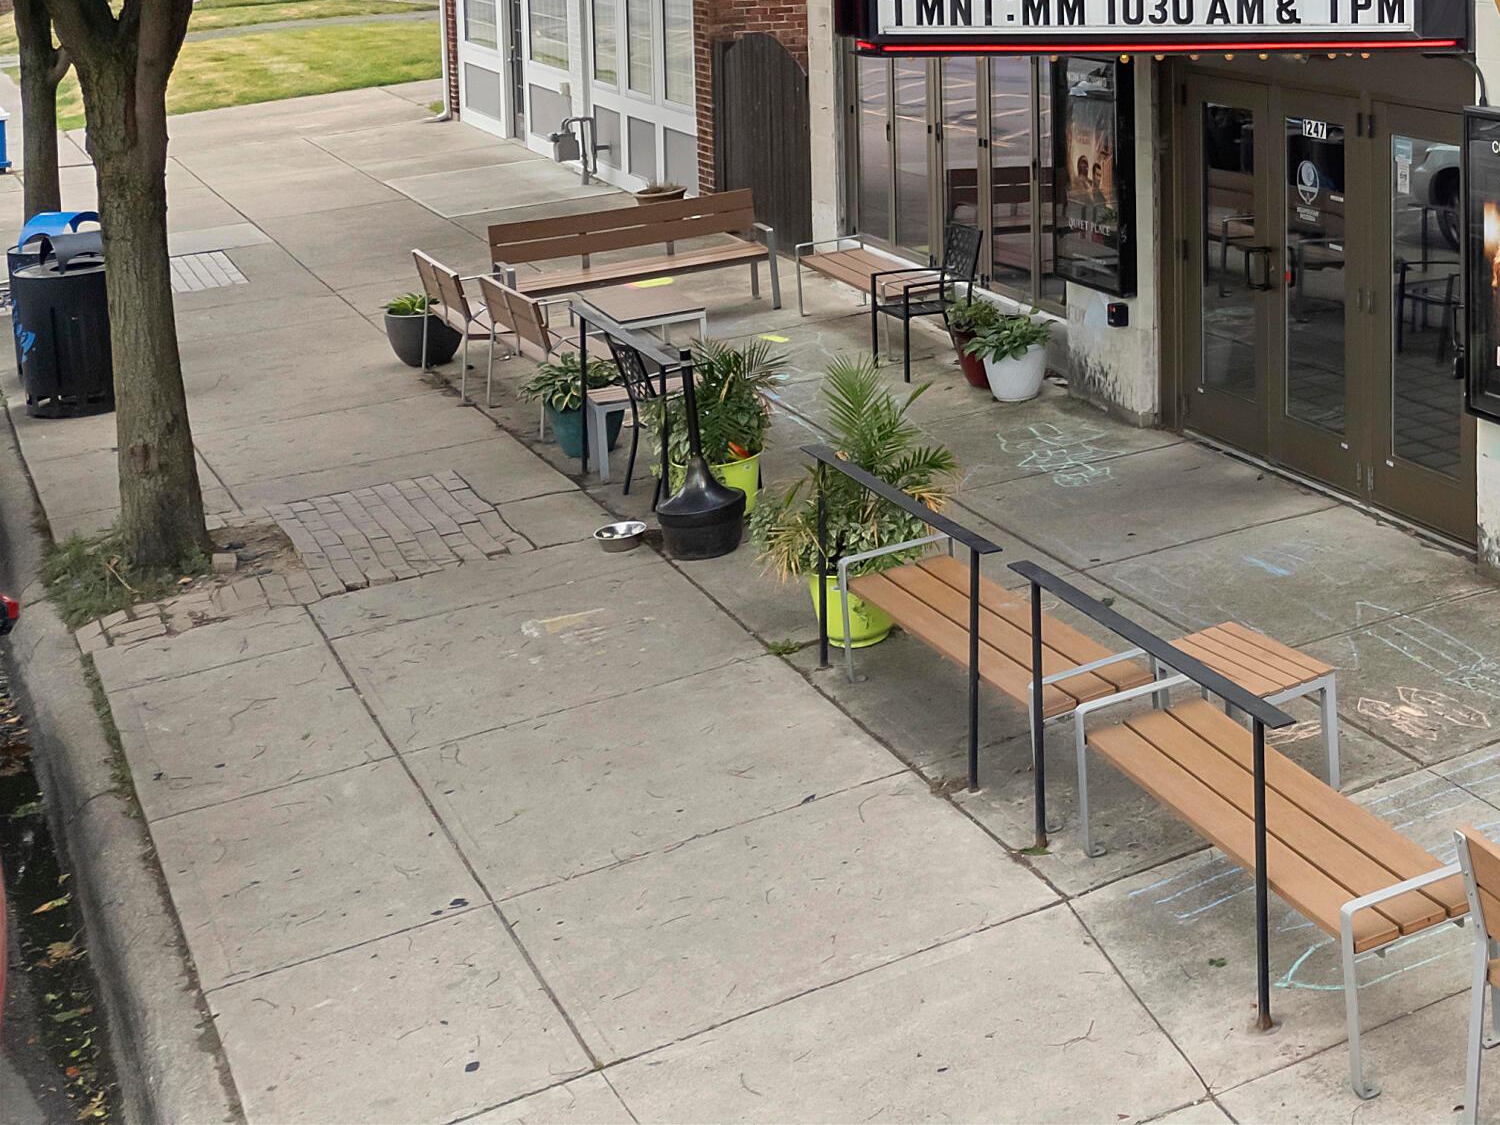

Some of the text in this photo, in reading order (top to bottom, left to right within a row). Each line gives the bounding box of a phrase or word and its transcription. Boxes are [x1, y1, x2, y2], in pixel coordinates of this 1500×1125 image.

[1303, 121, 1325, 139] 1247
[1068, 217, 1111, 236] QUIET PLACE
